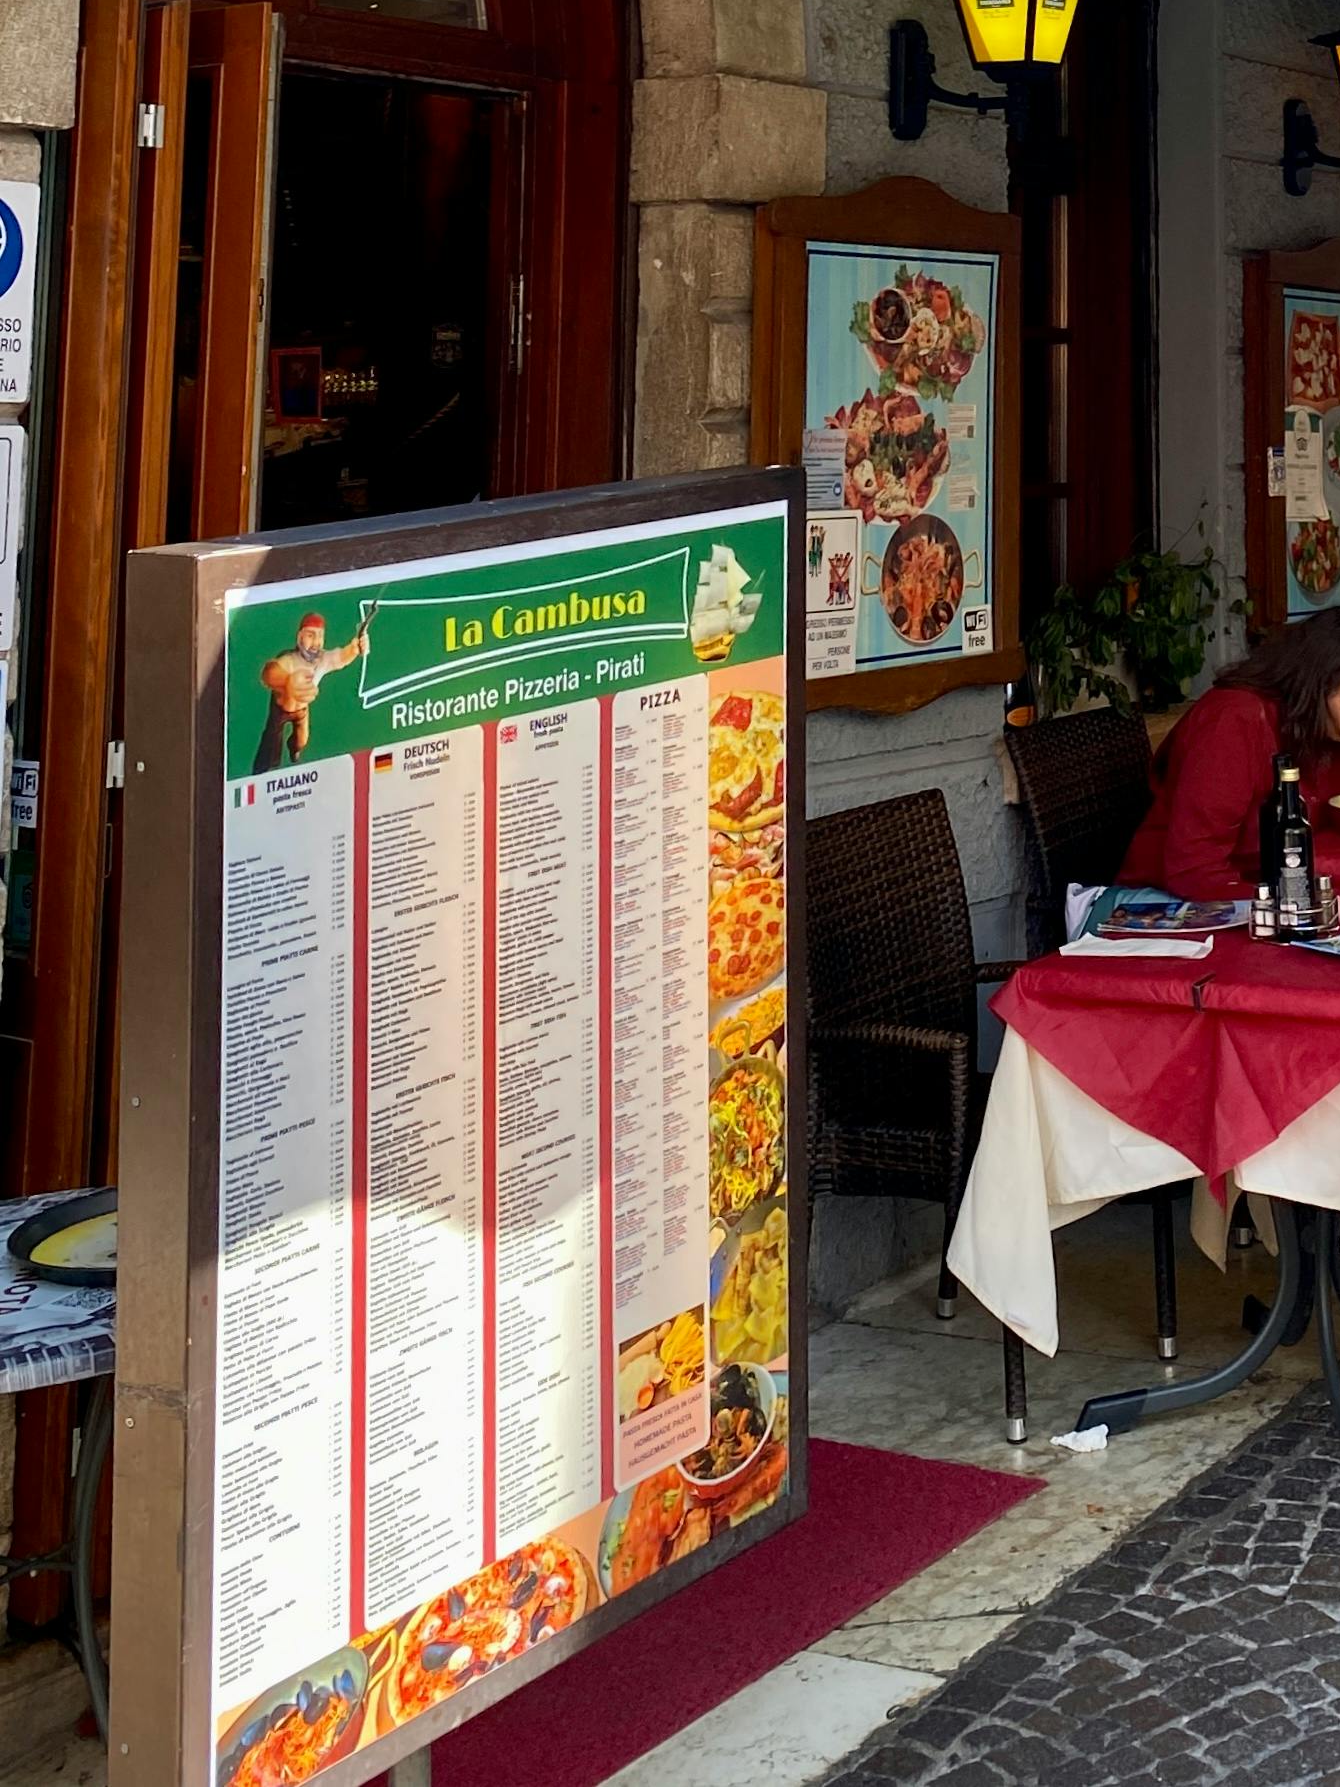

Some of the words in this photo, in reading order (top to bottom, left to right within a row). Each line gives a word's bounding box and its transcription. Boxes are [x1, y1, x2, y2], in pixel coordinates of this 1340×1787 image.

[445, 616, 483, 652] La
[491, 589, 646, 639] Cambusa
[968, 633, 986, 648] free
[392, 686, 498, 730] Ristorante
[504, 668, 580, 705] Pizzeria
[596, 651, 645, 685] Pirati
[640, 688, 681, 711] PIZZA
[529, 712, 568, 732] ENGLISH
[404, 739, 450, 760] DEUTSCH
[266, 771, 318, 794] ITALIANO
